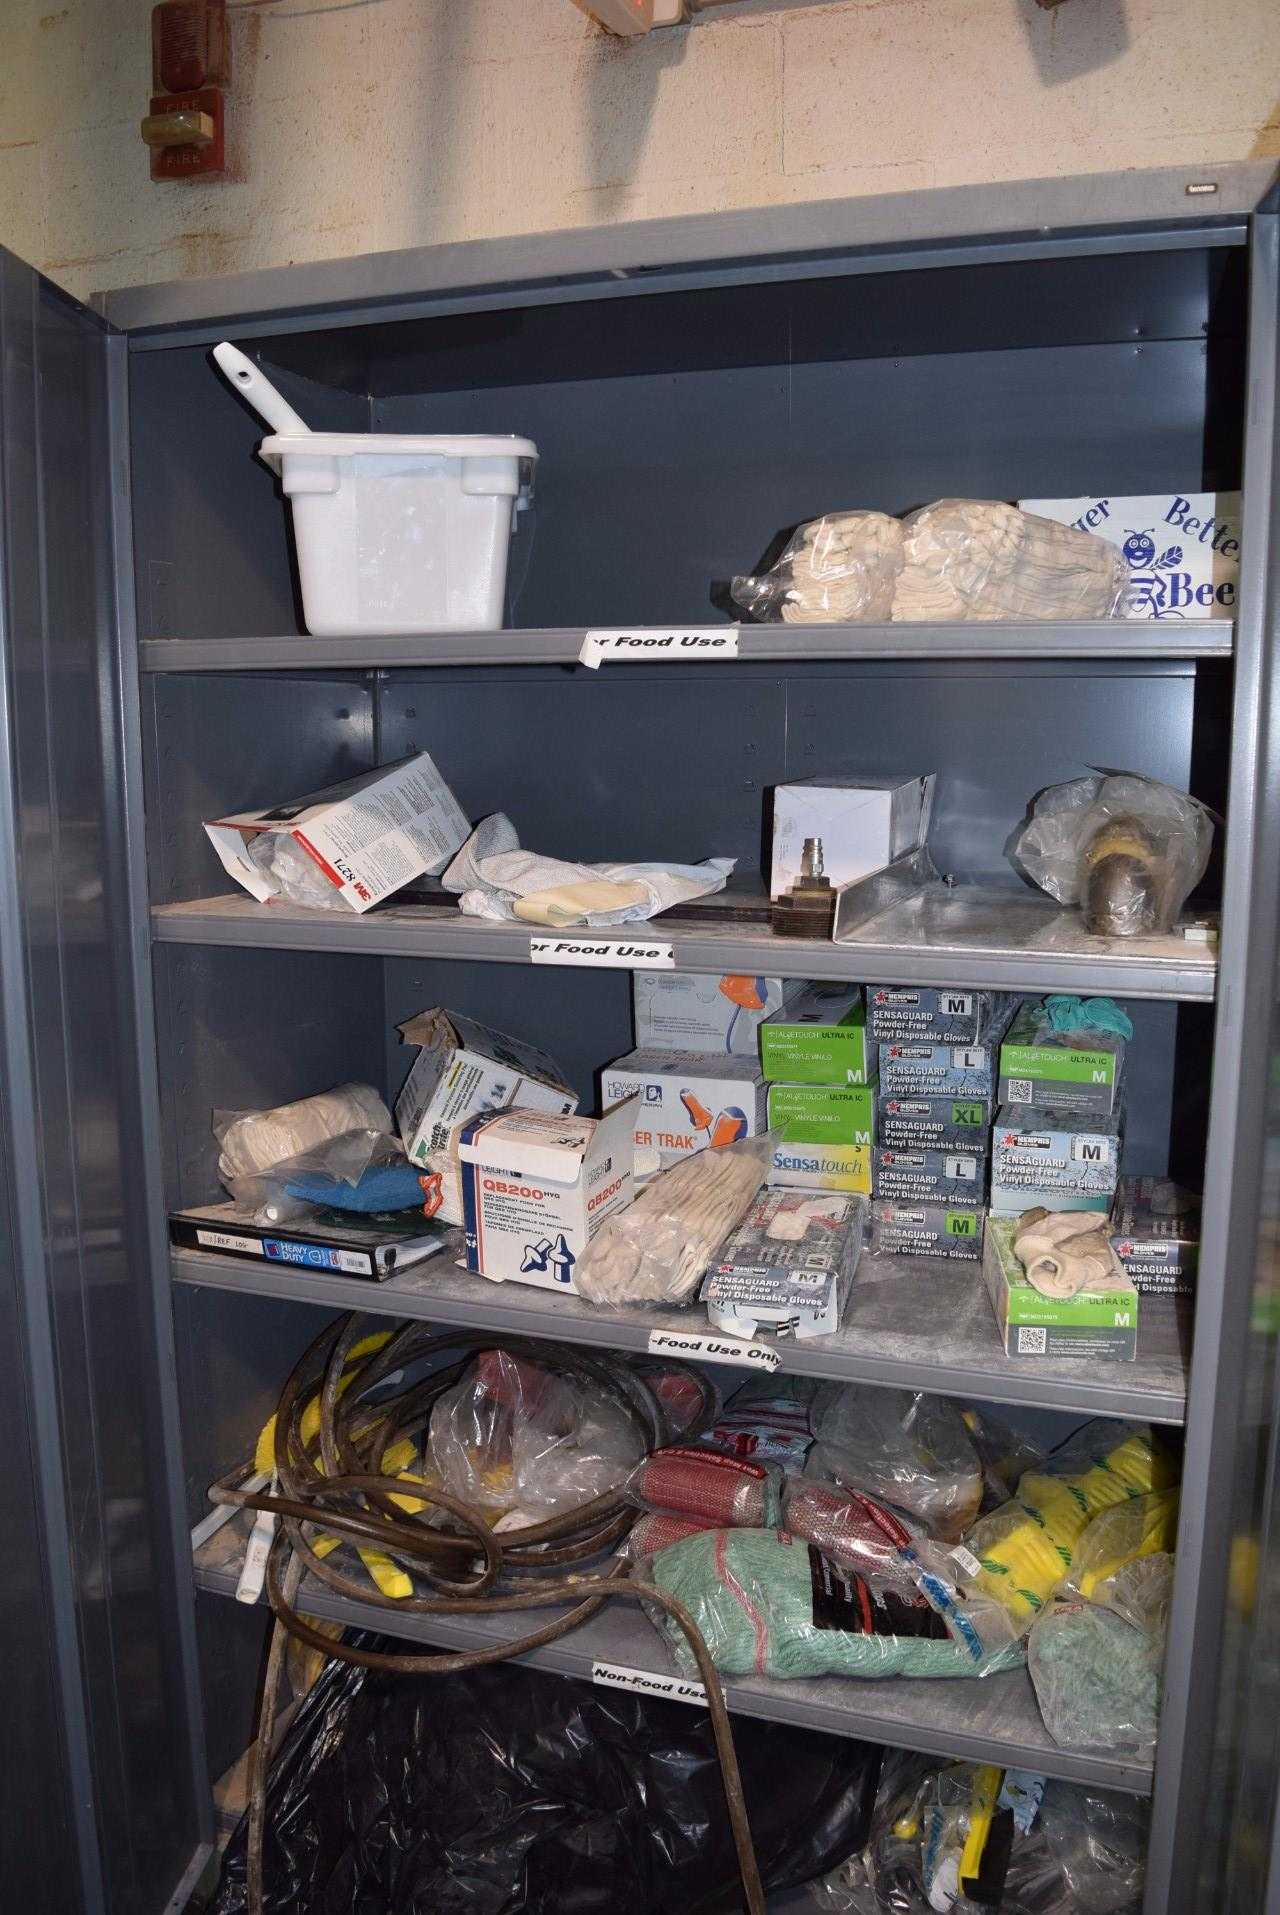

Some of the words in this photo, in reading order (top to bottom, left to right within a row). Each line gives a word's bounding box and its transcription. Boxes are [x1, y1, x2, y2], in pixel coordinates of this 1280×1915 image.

[614, 636, 674, 647] Food
[680, 636, 727, 647] Use
[332, 857, 357, 883] 8271
[554, 943, 610, 956] Food
[615, 946, 660, 958] Use
[888, 993, 918, 1001] MEMPHIS
[948, 999, 965, 1013] M
[873, 1010, 933, 1021] SENSAGUARD
[873, 1020, 927, 1030] Powder-Free
[822, 1032, 845, 1040] ULTRA
[873, 1029, 894, 1039] Vinyl
[896, 1031, 942, 1041] Disposable
[944, 1033, 971, 1042] Gloves
[901, 1047, 931, 1055] MEMPHIS
[964, 1053, 975, 1067] L
[1070, 1056, 1098, 1065] ULTRA
[847, 1069, 863, 1083] M
[886, 1066, 946, 1076] SENSAGUARD
[1092, 1070, 1106, 1083] M
[887, 1075, 940, 1085] Powder-Free
[830, 1093, 853, 1101] ULTRA
[887, 1084, 908, 1095] Vinyl
[911, 1085, 956, 1097] Disposable
[958, 1086, 987, 1096] Gloves
[900, 1103, 930, 1111] MEMPHIS
[954, 1108, 981, 1124] XL
[885, 1121, 944, 1132] SENSAGUARD
[855, 1131, 871, 1145] M
[885, 1130, 938, 1139] Powder-Free
[656, 1133, 694, 1150] TRAK
[885, 1138, 906, 1148] Vinyl
[908, 1139, 953, 1150] Disposable
[956, 1142, 984, 1152] Gloves
[1017, 1137, 1050, 1146] MEMPHIS
[894, 1154, 924, 1163] MEMPHIS
[1082, 1144, 1101, 1161] M
[773, 1152, 862, 1174] Sensatouch
[1000, 1154, 1066, 1169] SENSAGUARD
[955, 1163, 966, 1177] L
[1000, 1164, 1058, 1177] Powder-Free
[879, 1172, 937, 1185] SENSAGUARD
[1000, 1174, 1022, 1185] Vinyl
[1024, 1175, 1076, 1188] Disposable
[1077, 1180, 1110, 1190] Gloves
[483, 1179, 544, 1201] QB200
[879, 1181, 931, 1192] Powder-Free
[588, 1178, 622, 1212] QB200
[879, 1190, 900, 1200] Vinyl
[902, 1190, 946, 1202] Disposable
[949, 1194, 977, 1205] Gloves
[952, 1219, 970, 1234] M
[902, 1246, 948, 1258] Disposable
[949, 1250, 978, 1260] Gloves
[1133, 1244, 1167, 1253] MEMPHIS
[1123, 1263, 1182, 1275] ENSAGUARD
[712, 1275, 780, 1288] SENSAGUARD
[1130, 1273, 1176, 1284] wder-Free
[710, 1282, 771, 1294] Powder-Free
[733, 1291, 788, 1304] Disposable
[789, 1295, 823, 1307] Gloves
[1089, 1297, 1118, 1306] ULTRA
[1114, 1312, 1130, 1327] M
[707, 1343, 741, 1356] Use
[594, 1668, 674, 1693] Non-Food
[677, 1686, 709, 1700] Use
